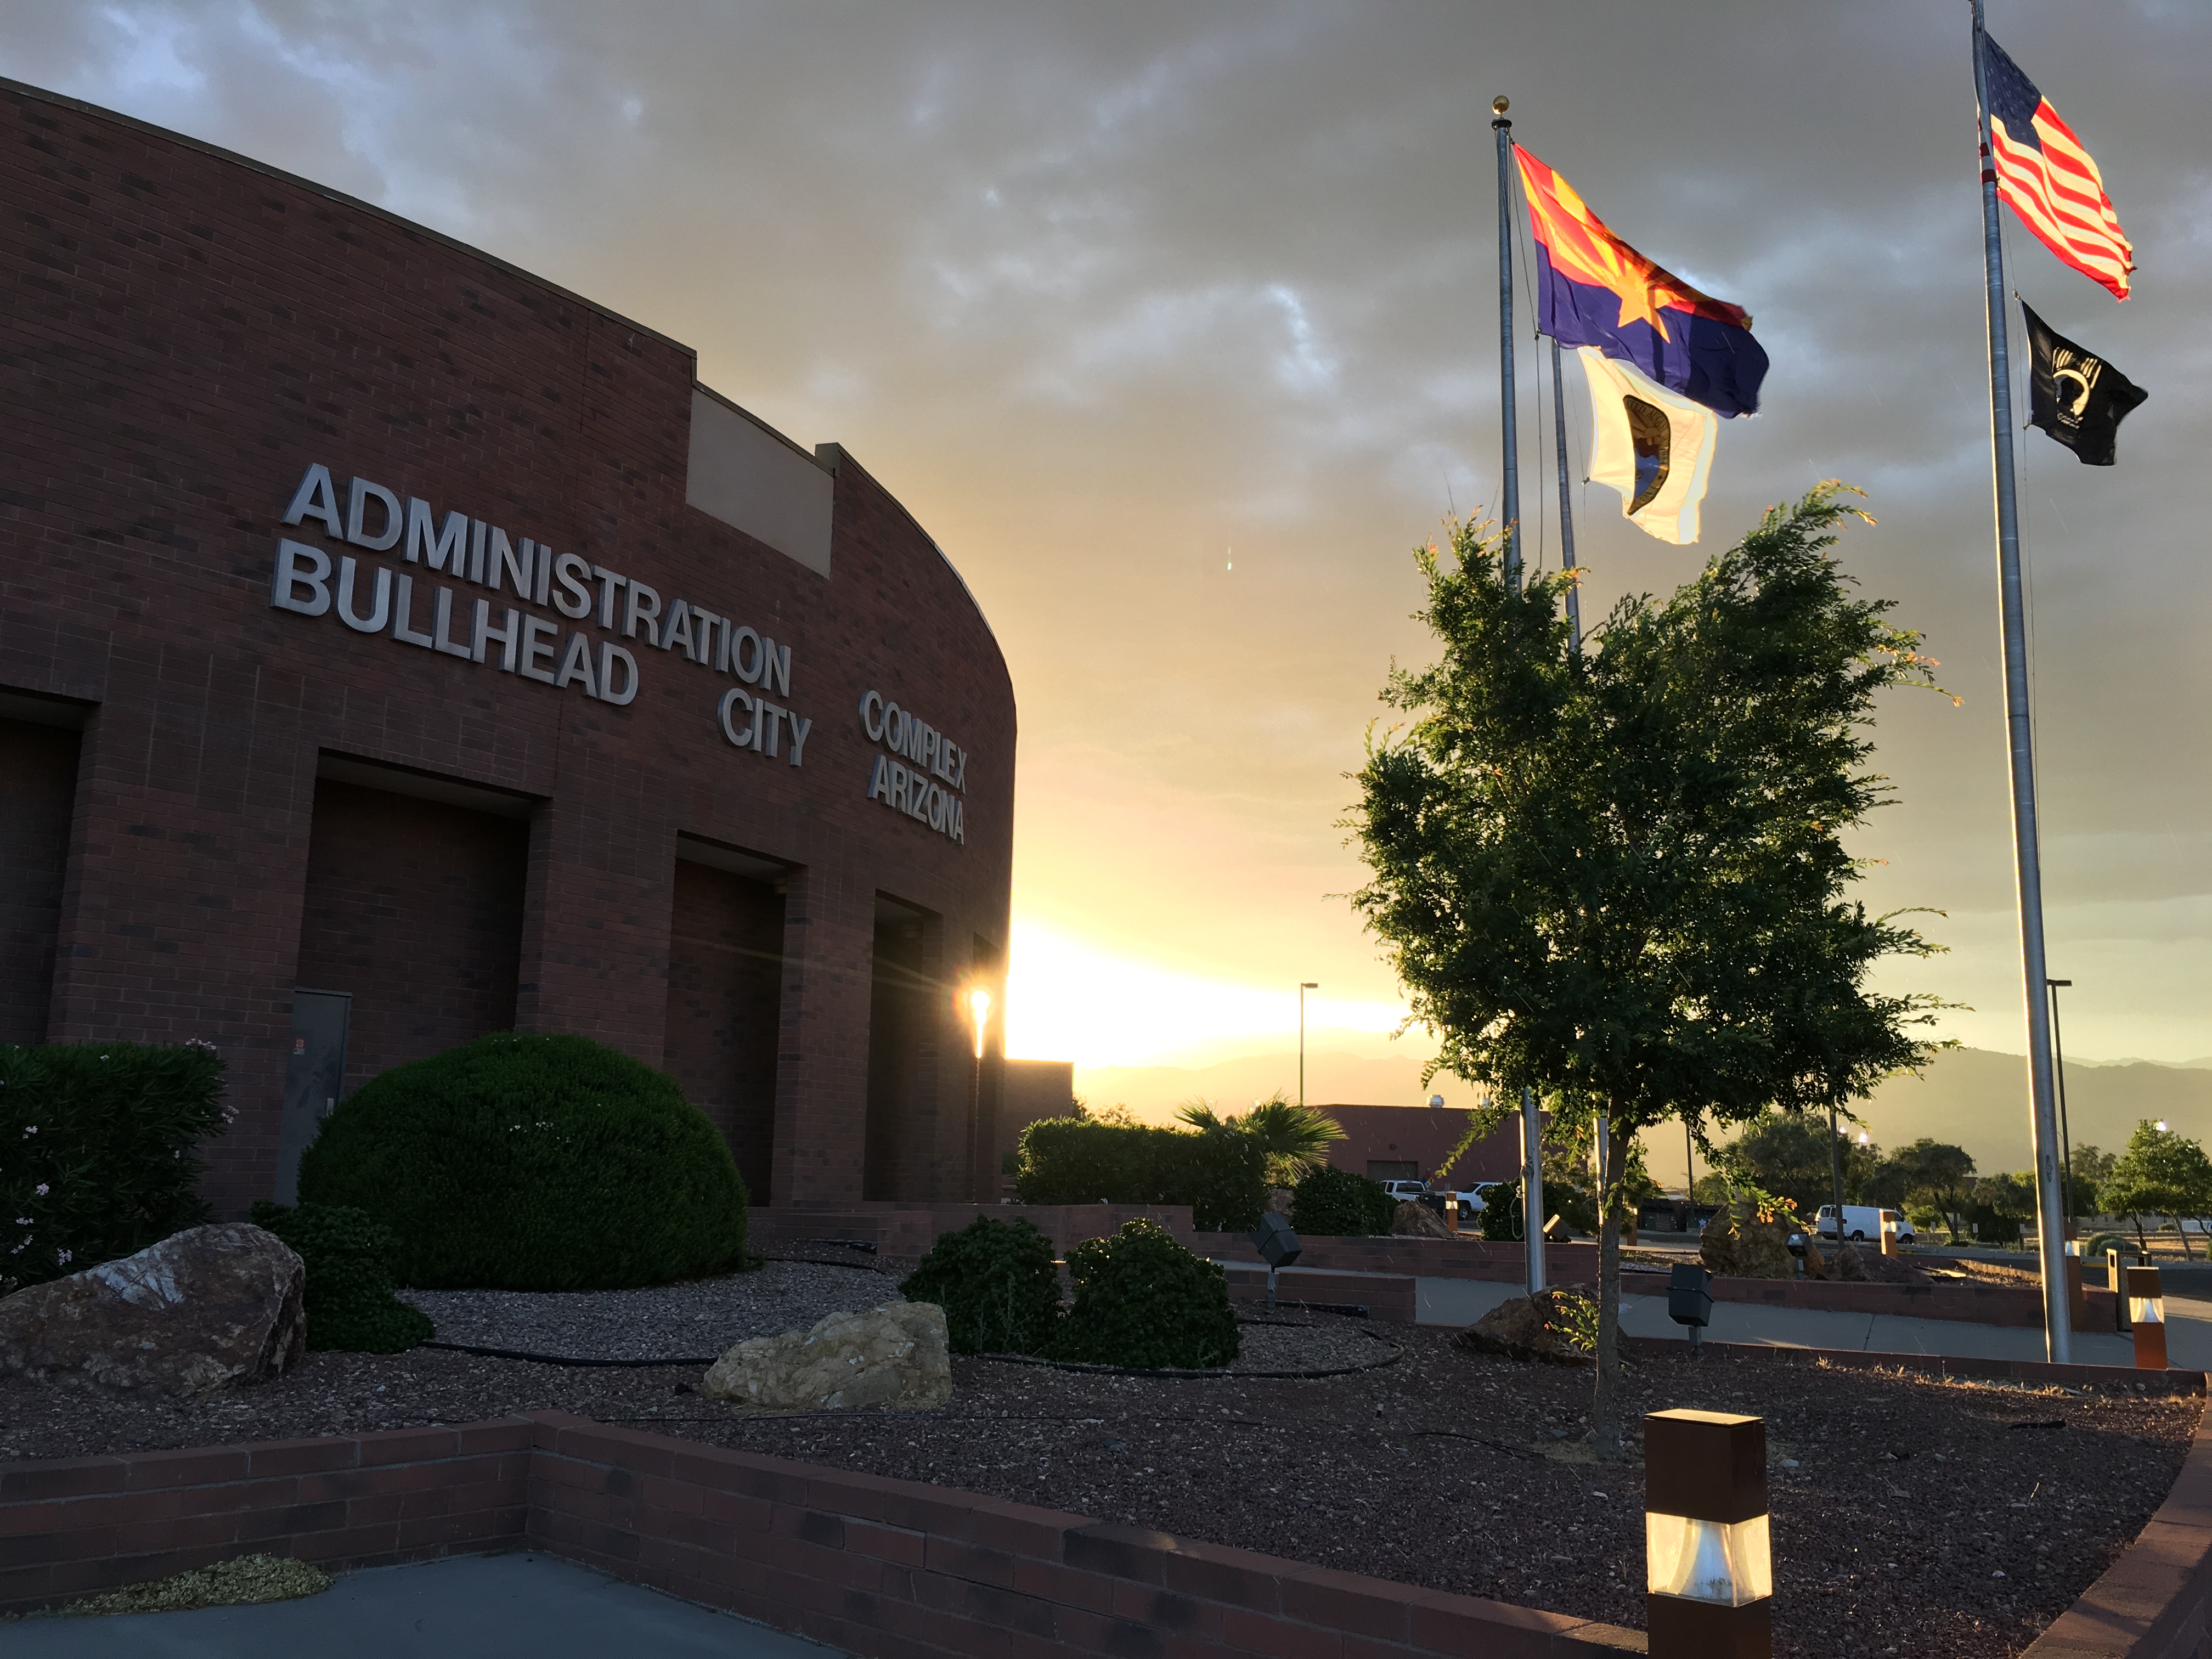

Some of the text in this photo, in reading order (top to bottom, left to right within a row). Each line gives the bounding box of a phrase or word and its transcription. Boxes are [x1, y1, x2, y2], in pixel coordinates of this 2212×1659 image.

[270, 538, 964, 845] BULLHEAD CITY ARIZONA
[281, 462, 967, 794] ADMINISTRATION COMPLEX
